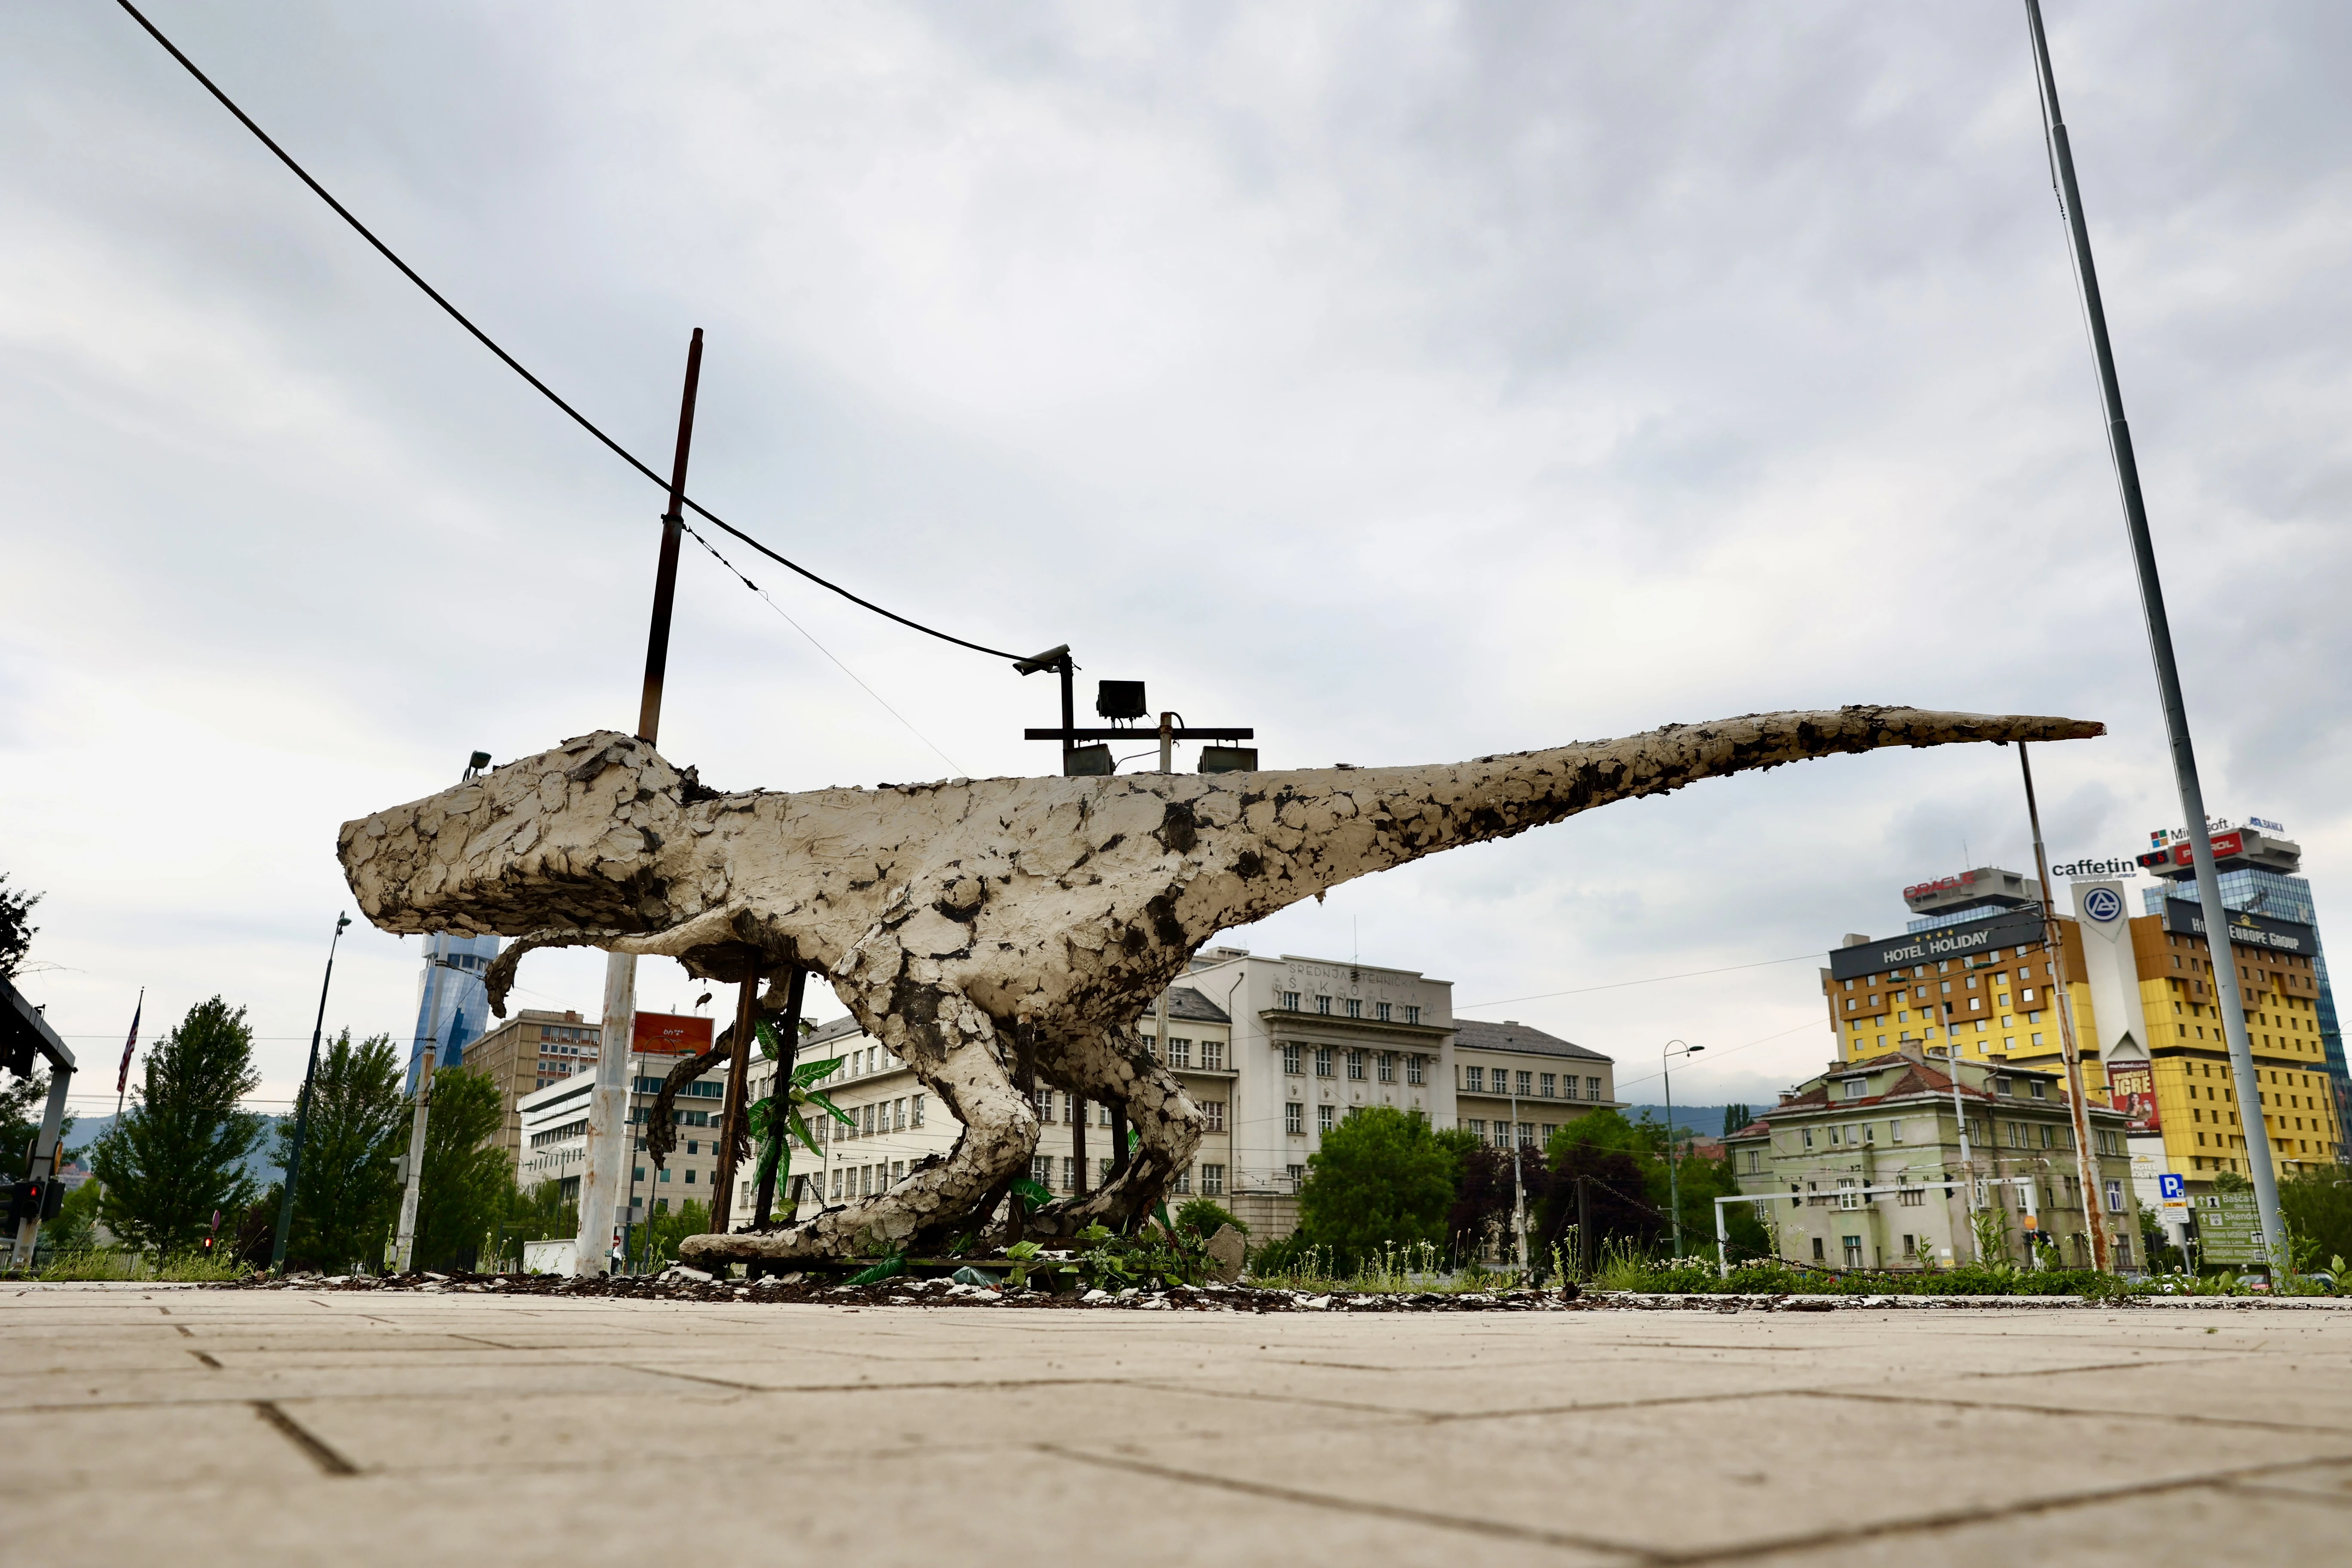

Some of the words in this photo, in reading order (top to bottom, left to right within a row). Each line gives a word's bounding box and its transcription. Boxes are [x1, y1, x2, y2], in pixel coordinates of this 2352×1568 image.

[2171, 818, 2228, 840] Misoft
[2182, 840, 2234, 858] PROL
[2052, 858, 2134, 876] caffetin
[1903, 871, 1975, 898] ORACLE
[1883, 945, 1925, 963] HOTEL
[1929, 931, 1989, 954] HOLIDAY
[1289, 964, 1347, 980] SREDNJA
[1361, 973, 1416, 988] TEHNIČKA
[2114, 1076, 2151, 1096] IGRE
[2164, 1177, 2178, 1195] P
